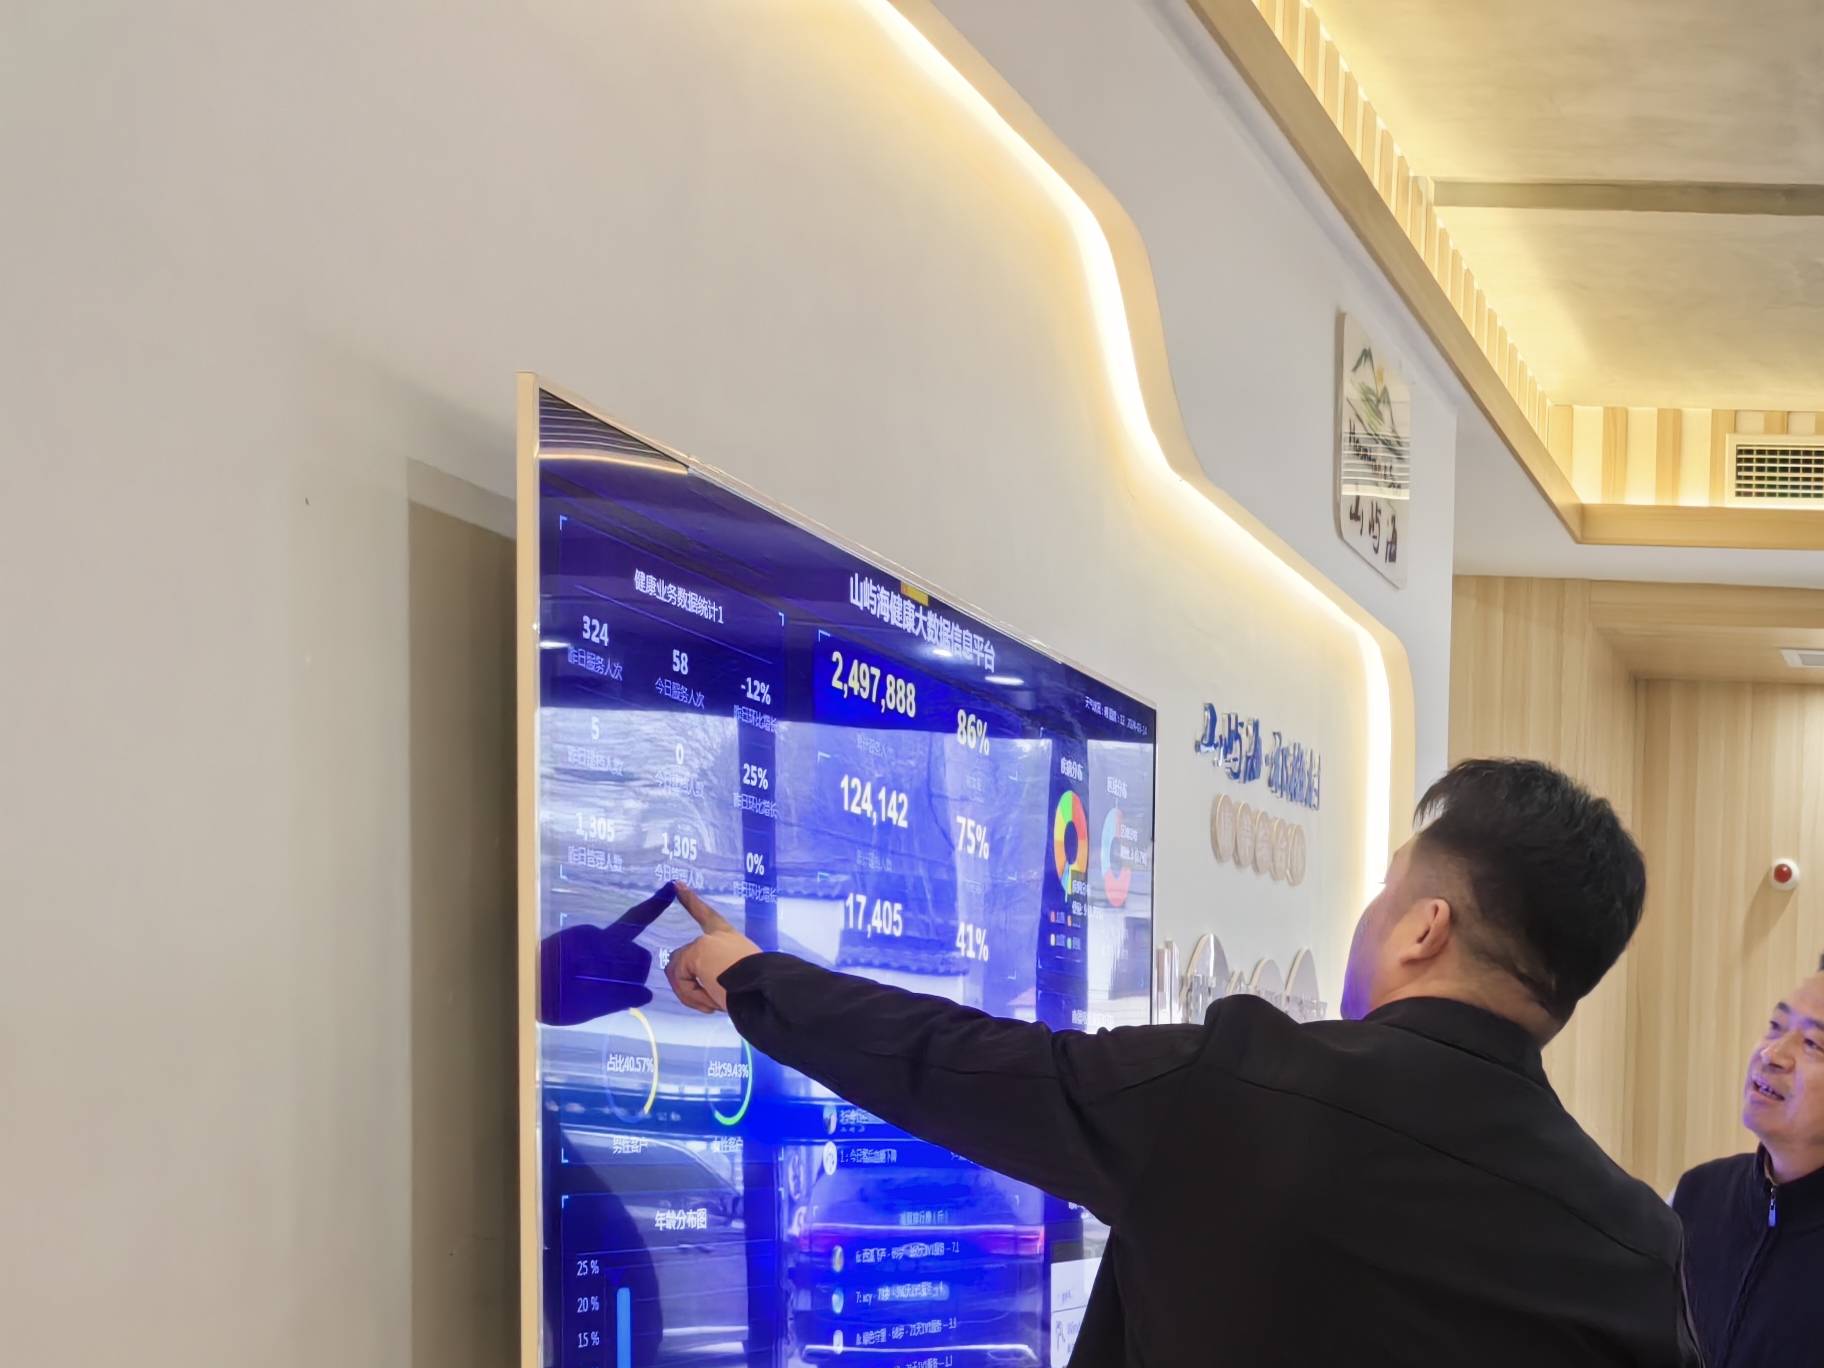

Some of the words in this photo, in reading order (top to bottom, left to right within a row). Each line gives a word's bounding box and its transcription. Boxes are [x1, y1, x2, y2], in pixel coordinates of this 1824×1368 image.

[634, 568, 724, 624] 健康业务数据统计1
[582, 615, 609, 646] 324
[850, 573, 996, 673] 山屿海健康大数据信息平台
[567, 648, 623, 681] 昨日服务人次
[672, 649, 688, 675] 58
[655, 677, 704, 709] 今日服务人次
[740, 677, 771, 705] -12%
[832, 651, 916, 718] 2,497,888
[591, 716, 600, 740] 5
[957, 709, 990, 755] 86%
[675, 743, 684, 765] 0
[743, 763, 768, 790] 25%
[840, 774, 908, 828] 124,142
[576, 813, 615, 842] 1,305
[956, 815, 989, 860] 75%
[661, 832, 697, 861] 1,305
[746, 852, 764, 876] 0%
[846, 892, 903, 938] 17,405
[955, 921, 989, 962] 41%
[607, 1053, 654, 1074] 占比40.57%
[707, 1059, 749, 1078] 占比59.43%
[655, 1208, 707, 1231] 年龄分布图
[577, 1261, 589, 1276] 25
[591, 1260, 600, 1274] %
[577, 1297, 589, 1313] 20
[591, 1296, 600, 1311] %
[578, 1333, 589, 1348] 15
[591, 1331, 600, 1346] %
